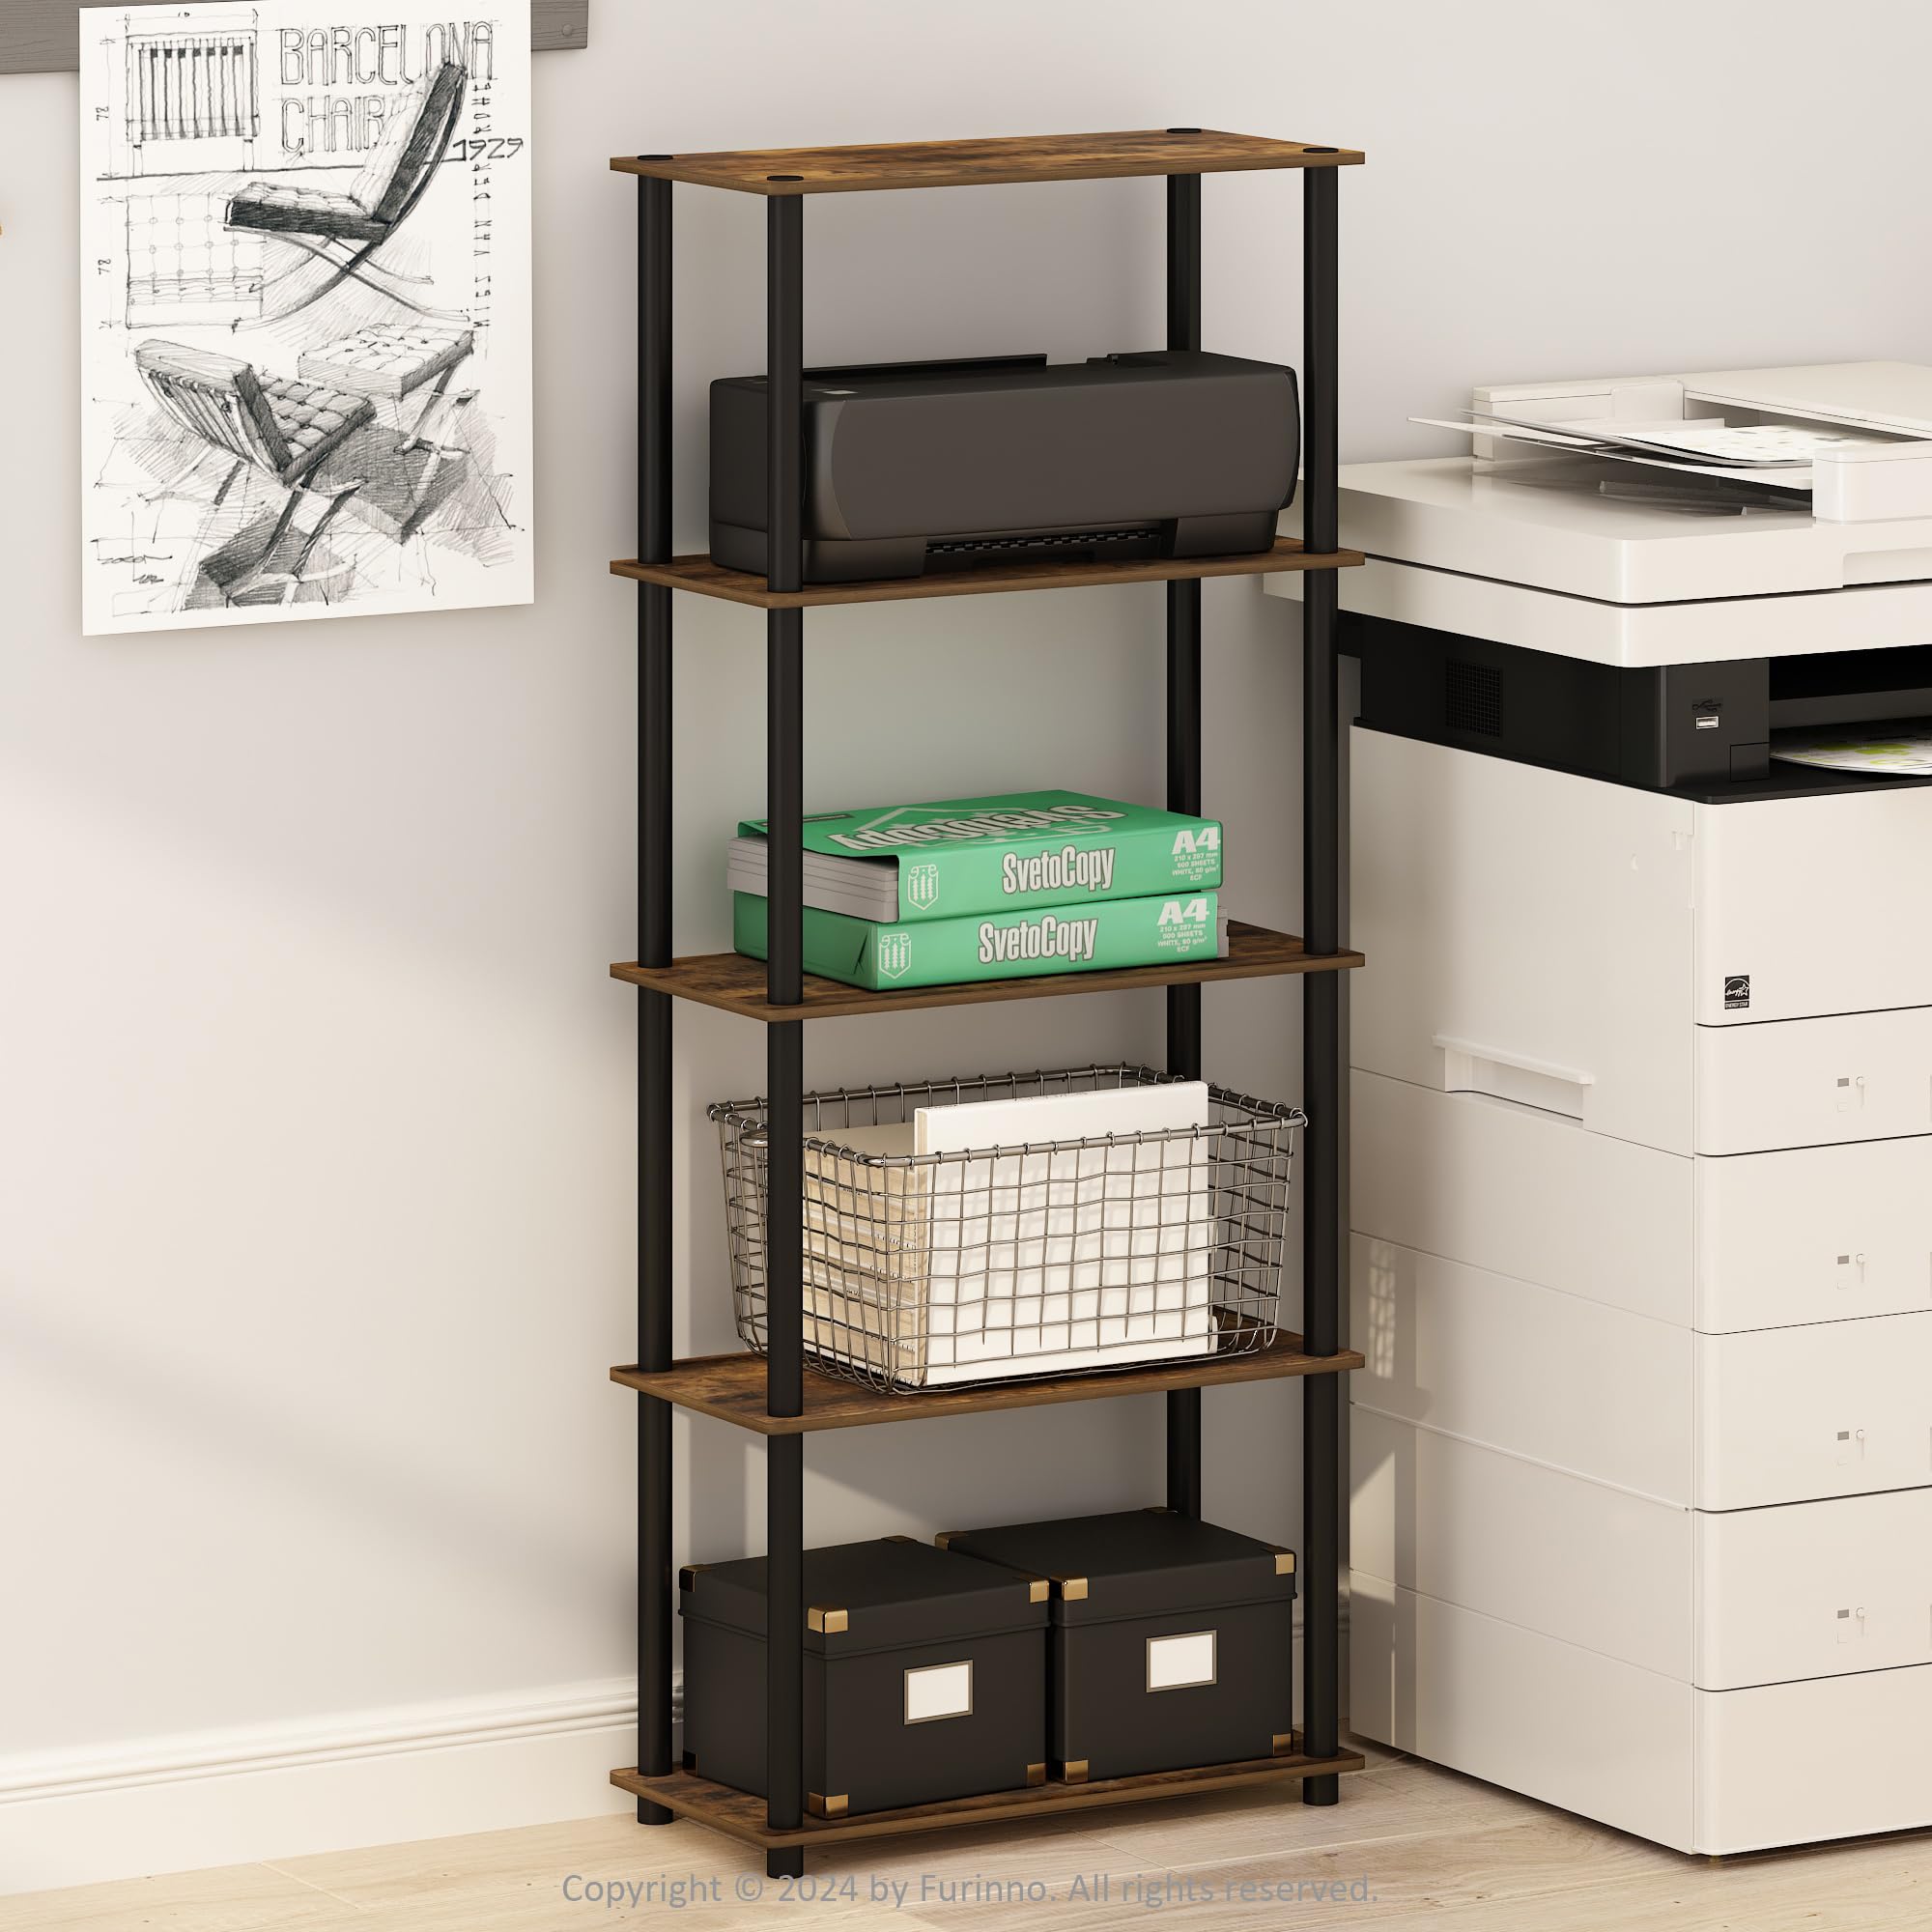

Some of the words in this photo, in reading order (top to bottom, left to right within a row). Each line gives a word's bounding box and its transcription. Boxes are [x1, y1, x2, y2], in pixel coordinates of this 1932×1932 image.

[280, 20, 493, 86] BARCELONA
[281, 95, 386, 153] CHAIR
[451, 137, 524, 161] 1929
[1172, 827, 1221, 855] A4
[1002, 845, 1116, 895] SvetoCopy
[1157, 898, 1209, 925] A4
[978, 915, 1098, 965] SvetoCopy
